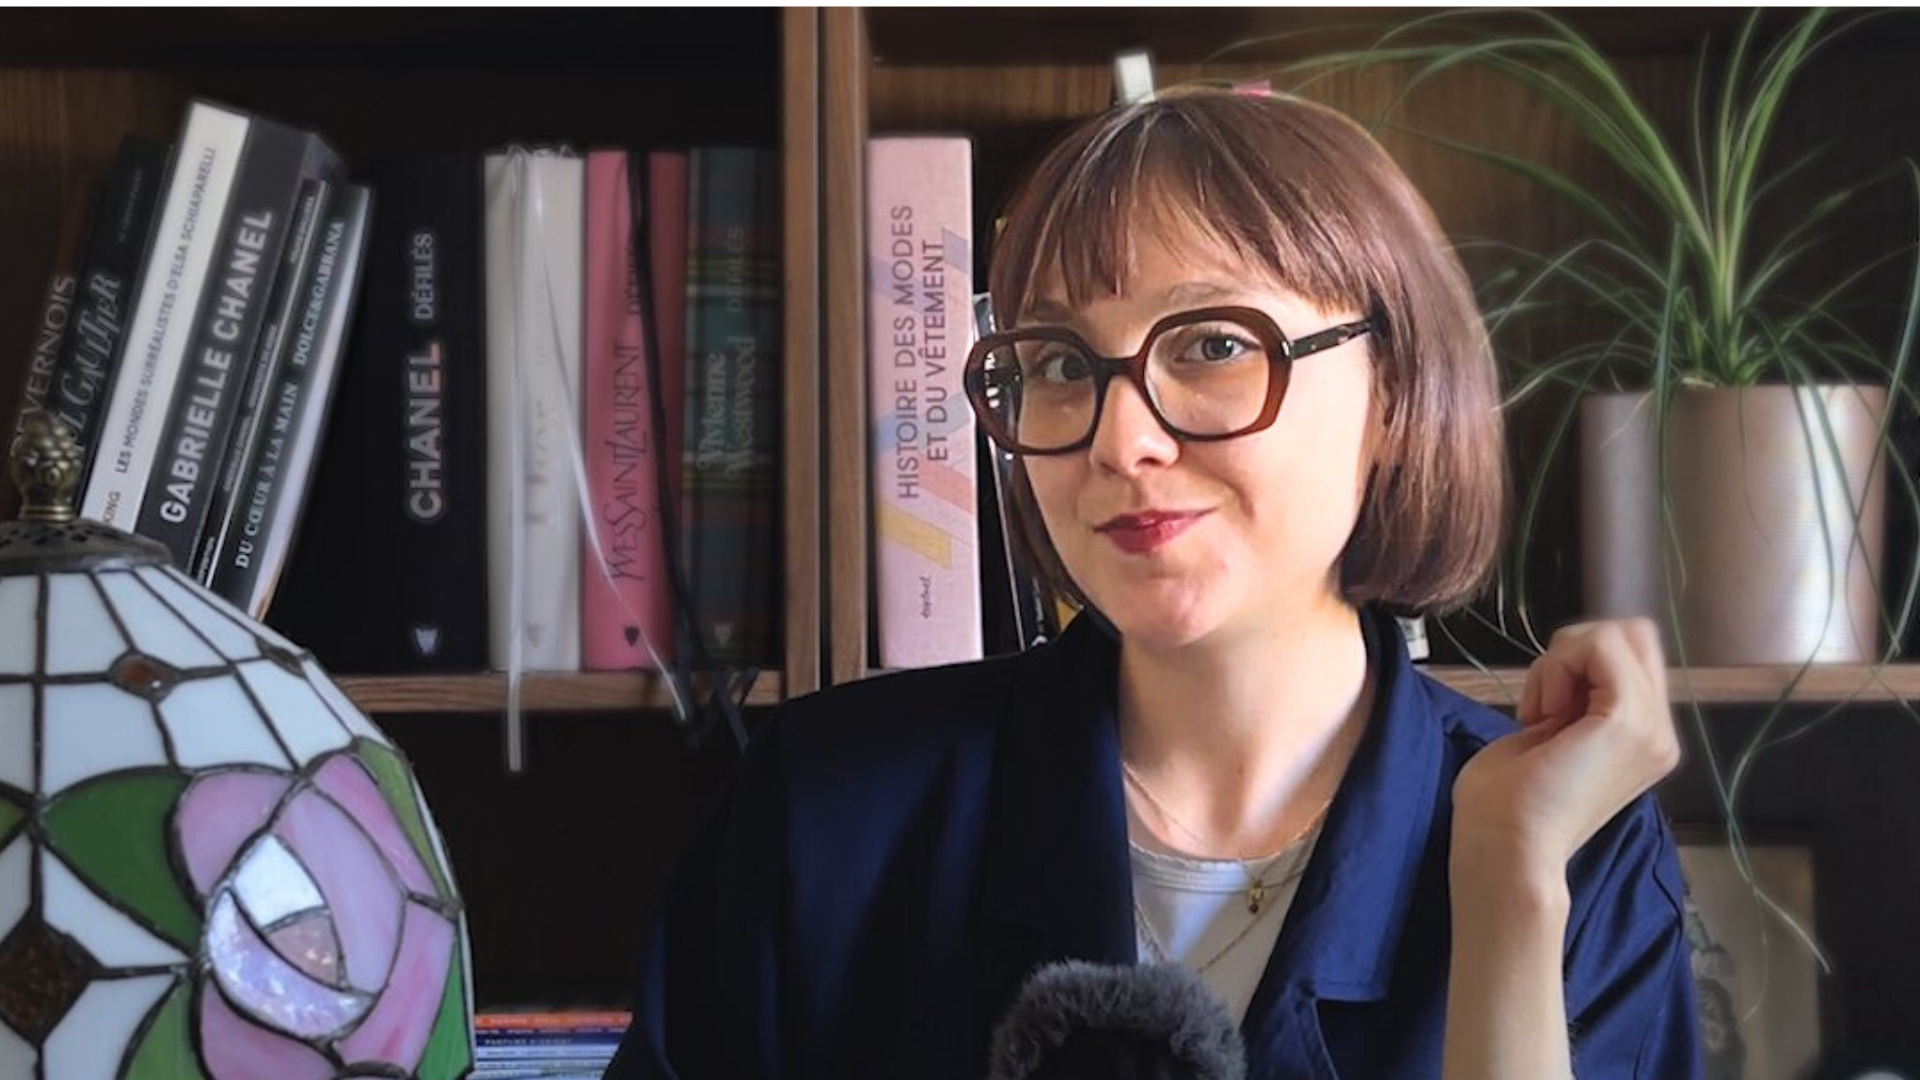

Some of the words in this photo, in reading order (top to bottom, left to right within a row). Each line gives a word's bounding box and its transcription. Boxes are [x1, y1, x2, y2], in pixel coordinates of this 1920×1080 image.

[180, 148, 216, 242] SCHIAPARELLI
[165, 243, 190, 291] D'ELSA
[293, 221, 345, 366] DOLCE&GABBANA
[411, 233, 433, 320] DÉFILÉS
[891, 206, 914, 304] MODES
[140, 291, 177, 387] SURRÉALISTES
[893, 316, 916, 367] DES
[918, 240, 946, 378] VÊTEMENT
[159, 348, 232, 525] GABRIELLE
[212, 207, 272, 343] CHANEL
[271, 381, 299, 434] MAIN
[724, 335, 757, 478] Westwood
[926, 387, 948, 427] DU
[121, 389, 150, 449] MONDES
[264, 436, 284, 460] LA
[410, 342, 442, 519] CHANEL
[696, 352, 727, 471] Vivienne
[895, 379, 919, 499] HISTOIRE
[926, 432, 948, 461] ET
[115, 449, 132, 474] LES
[233, 539, 255, 569] DU
